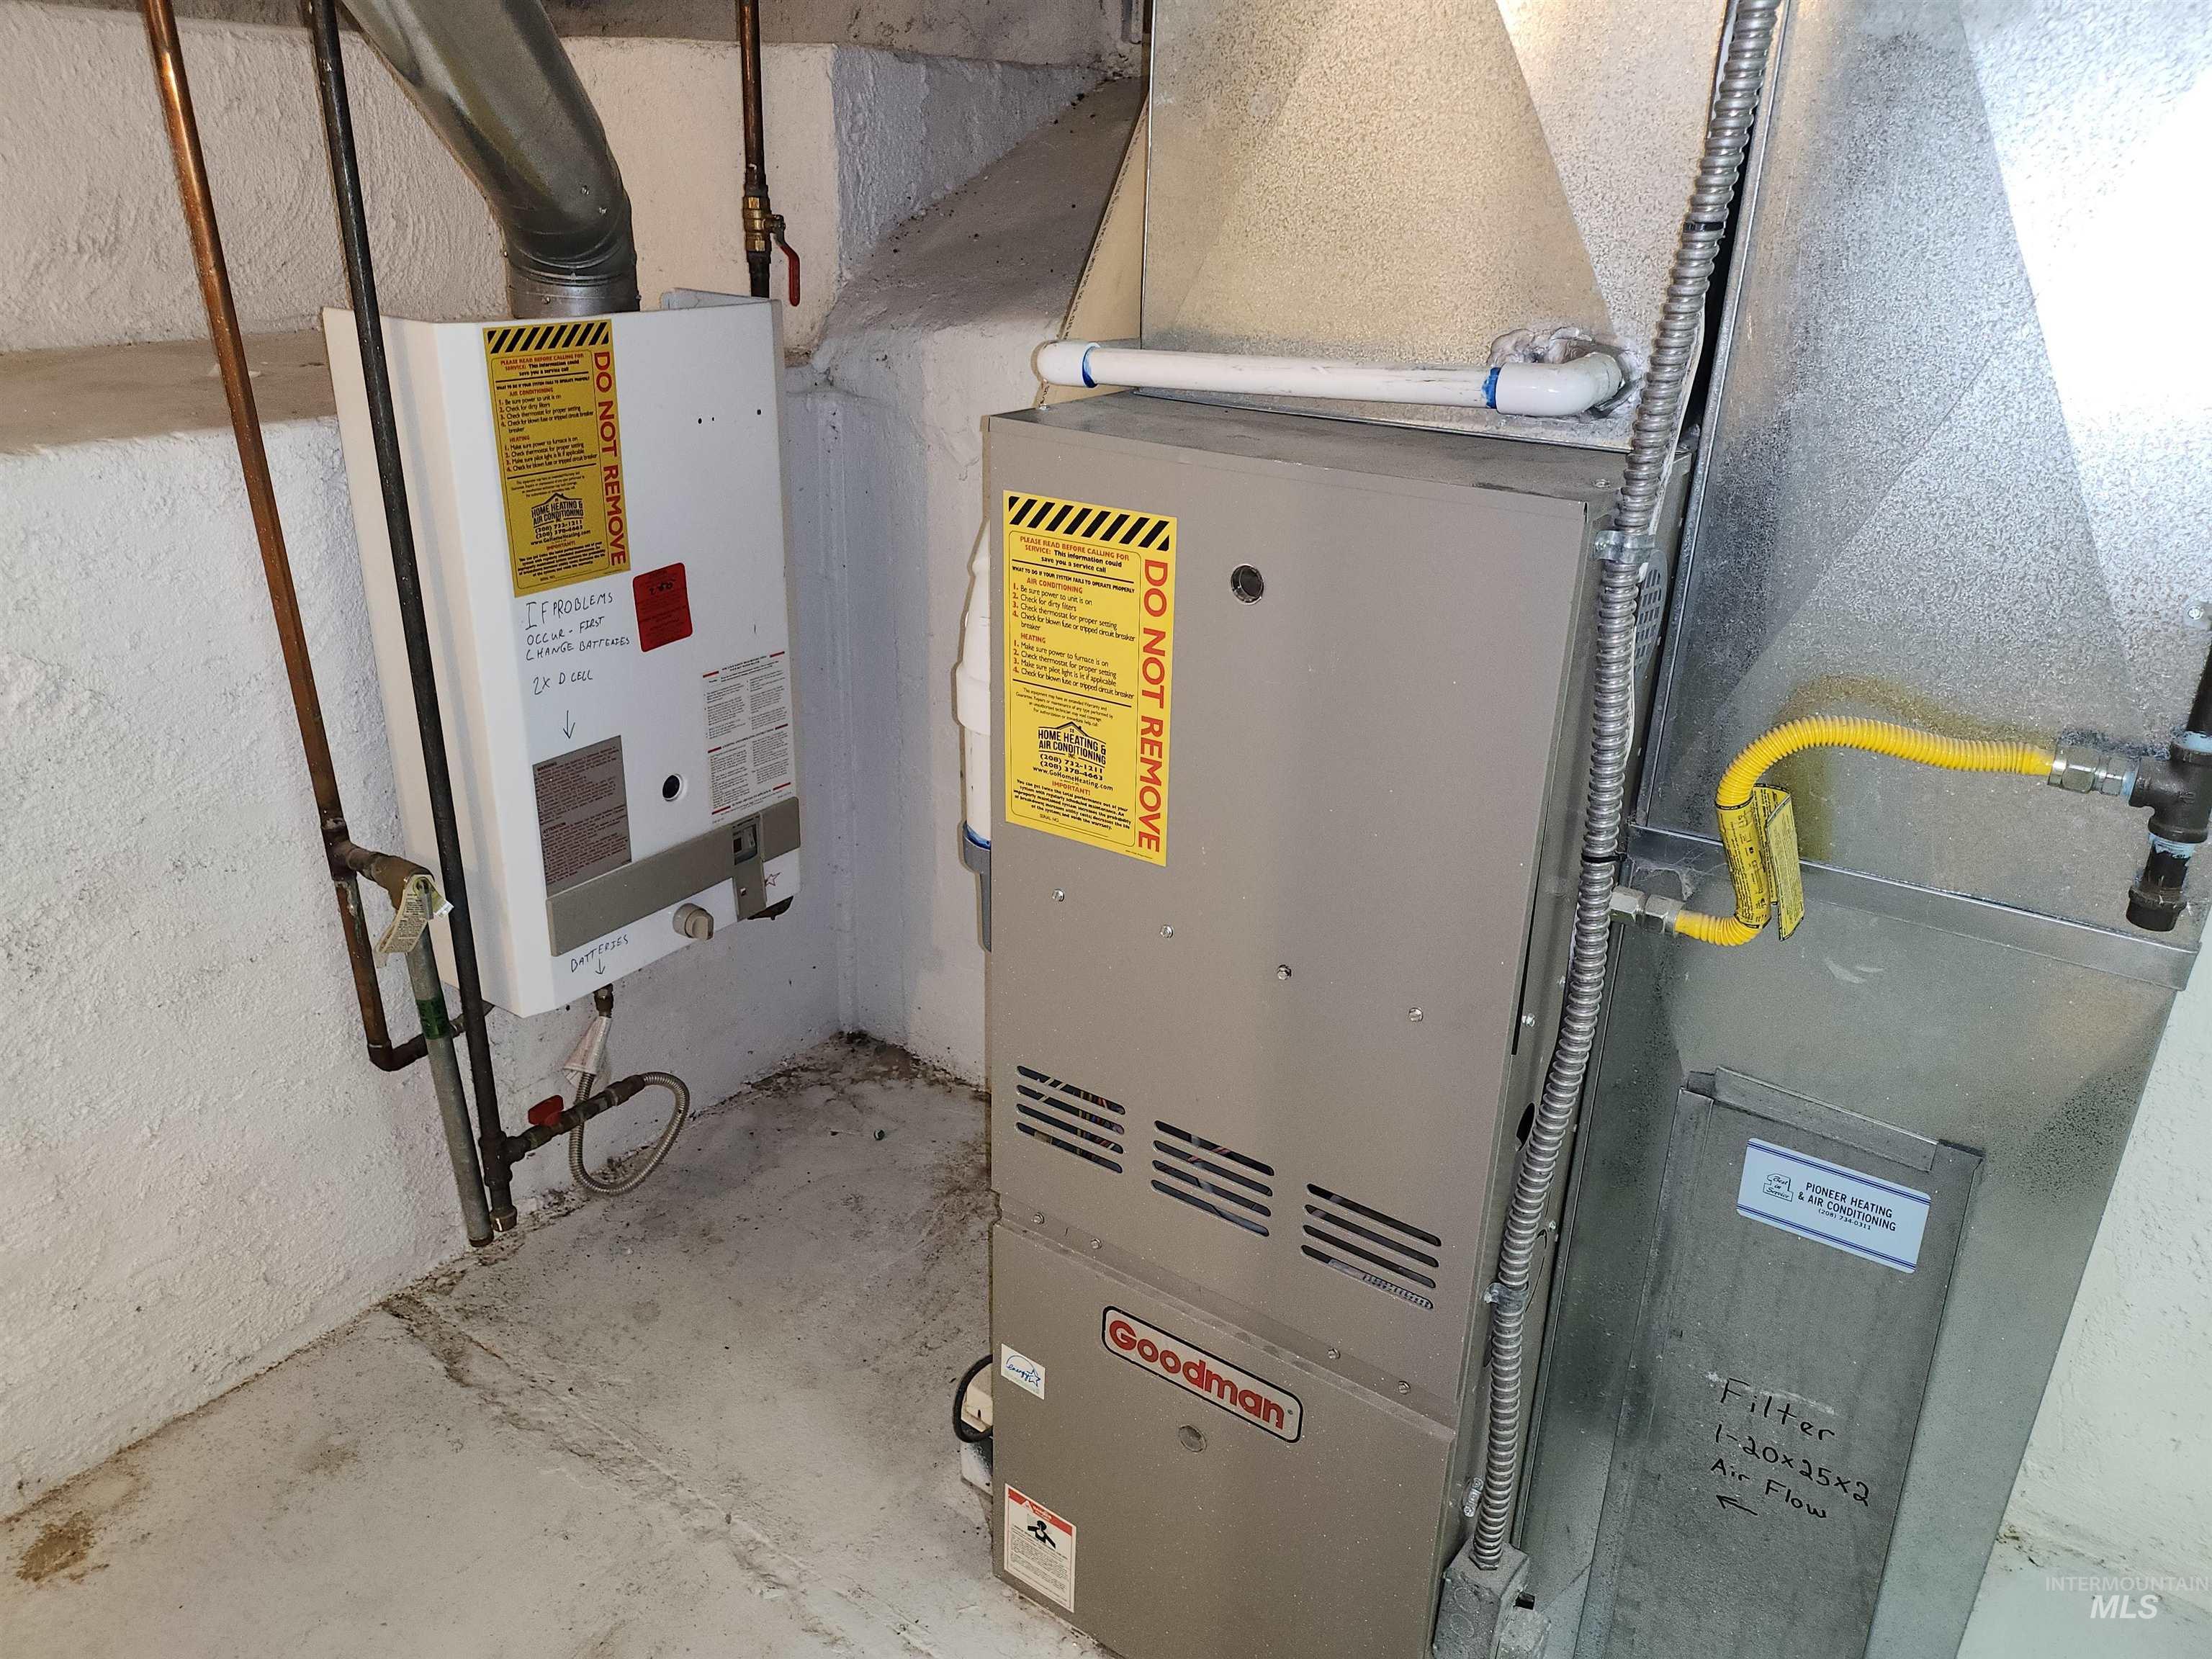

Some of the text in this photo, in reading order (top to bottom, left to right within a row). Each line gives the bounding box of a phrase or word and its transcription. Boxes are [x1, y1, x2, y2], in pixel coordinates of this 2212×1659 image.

[594, 351, 626, 567] DO NOT REMOVE
[531, 503, 550, 518] HOME
[551, 501, 577, 512] HEATING
[533, 508, 584, 526] AIR CONDITIONING
[1020, 536, 1129, 561] PLEASE READ BEFORE CALLING FOR
[1025, 544, 1051, 554] SERVICE:
[1067, 551, 1103, 564] information
[1073, 562, 1094, 570] service
[1020, 584, 1027, 592] Be
[1041, 590, 1058, 599] power
[1038, 579, 1082, 594] CONDITIONING
[1144, 559, 1168, 617] DO
[553, 592, 613, 619] PROBLEMS
[1020, 593, 1037, 604] Check
[1038, 597, 1046, 605] for
[1047, 599, 1060, 609] dirty
[1061, 601, 1076, 611] filters
[1020, 603, 1037, 613] Check
[1038, 606, 1068, 619] thermostat
[1078, 616, 1097, 625] proper
[1099, 620, 1117, 630] setting
[1020, 620, 1040, 630] breaker
[1020, 611, 1036, 621] Check
[1045, 616, 1061, 626] blown
[1061, 620, 1071, 628] fuse
[1079, 625, 1098, 634] tripped
[1098, 628, 1114, 637] circuit
[1115, 631, 1135, 641] breaker
[526, 631, 565, 646] OCCUR
[580, 616, 605, 634] FIRST
[1020, 632, 1045, 643] HEATING
[526, 643, 574, 661] CHANGE
[1020, 641, 1034, 651] Make
[1048, 649, 1065, 658] power
[1074, 652, 1094, 664] furnace
[1021, 650, 1037, 660] Check
[1038, 654, 1068, 667] thermostat
[1069, 660, 1077, 668] for
[1078, 664, 1097, 673] proper
[1098, 669, 1116, 679] setting
[1021, 658, 1034, 668] Make
[1048, 666, 1060, 674] pilot
[1061, 667, 1072, 677] light
[1090, 676, 1116, 686] applicable
[1142, 628, 1166, 709] NOT
[533, 670, 593, 695] 2X D CELL
[1021, 667, 1036, 677] Check
[1045, 673, 1061, 682] blown
[1061, 676, 1071, 685] fuse
[1079, 681, 1097, 691] tripped
[1098, 685, 1113, 695] circuit
[1114, 689, 1134, 699] breaker
[1038, 729, 1106, 756] HOME HEATING &
[1039, 740, 1106, 765] AIR CONDITIONING
[1040, 753, 1102, 773] (208) 732-1211
[1032, 766, 1113, 791] www.GoHomeHeating.com
[1052, 780, 1090, 795] IMPORTANT!
[1138, 715, 1164, 853] REMOVE
[571, 934, 629, 973] BATTERIES
[1798, 1192, 1896, 1232] & AIR CONDITIONING
[1806, 1182, 1892, 1218] PIONEER HEATING
[1818, 1208, 1871, 1230] (208) 734-0311
[1109, 1320, 1285, 1430] Goodman
[1720, 1377, 1835, 1441] Filter
[1710, 1458, 1827, 1519] Air Flow
